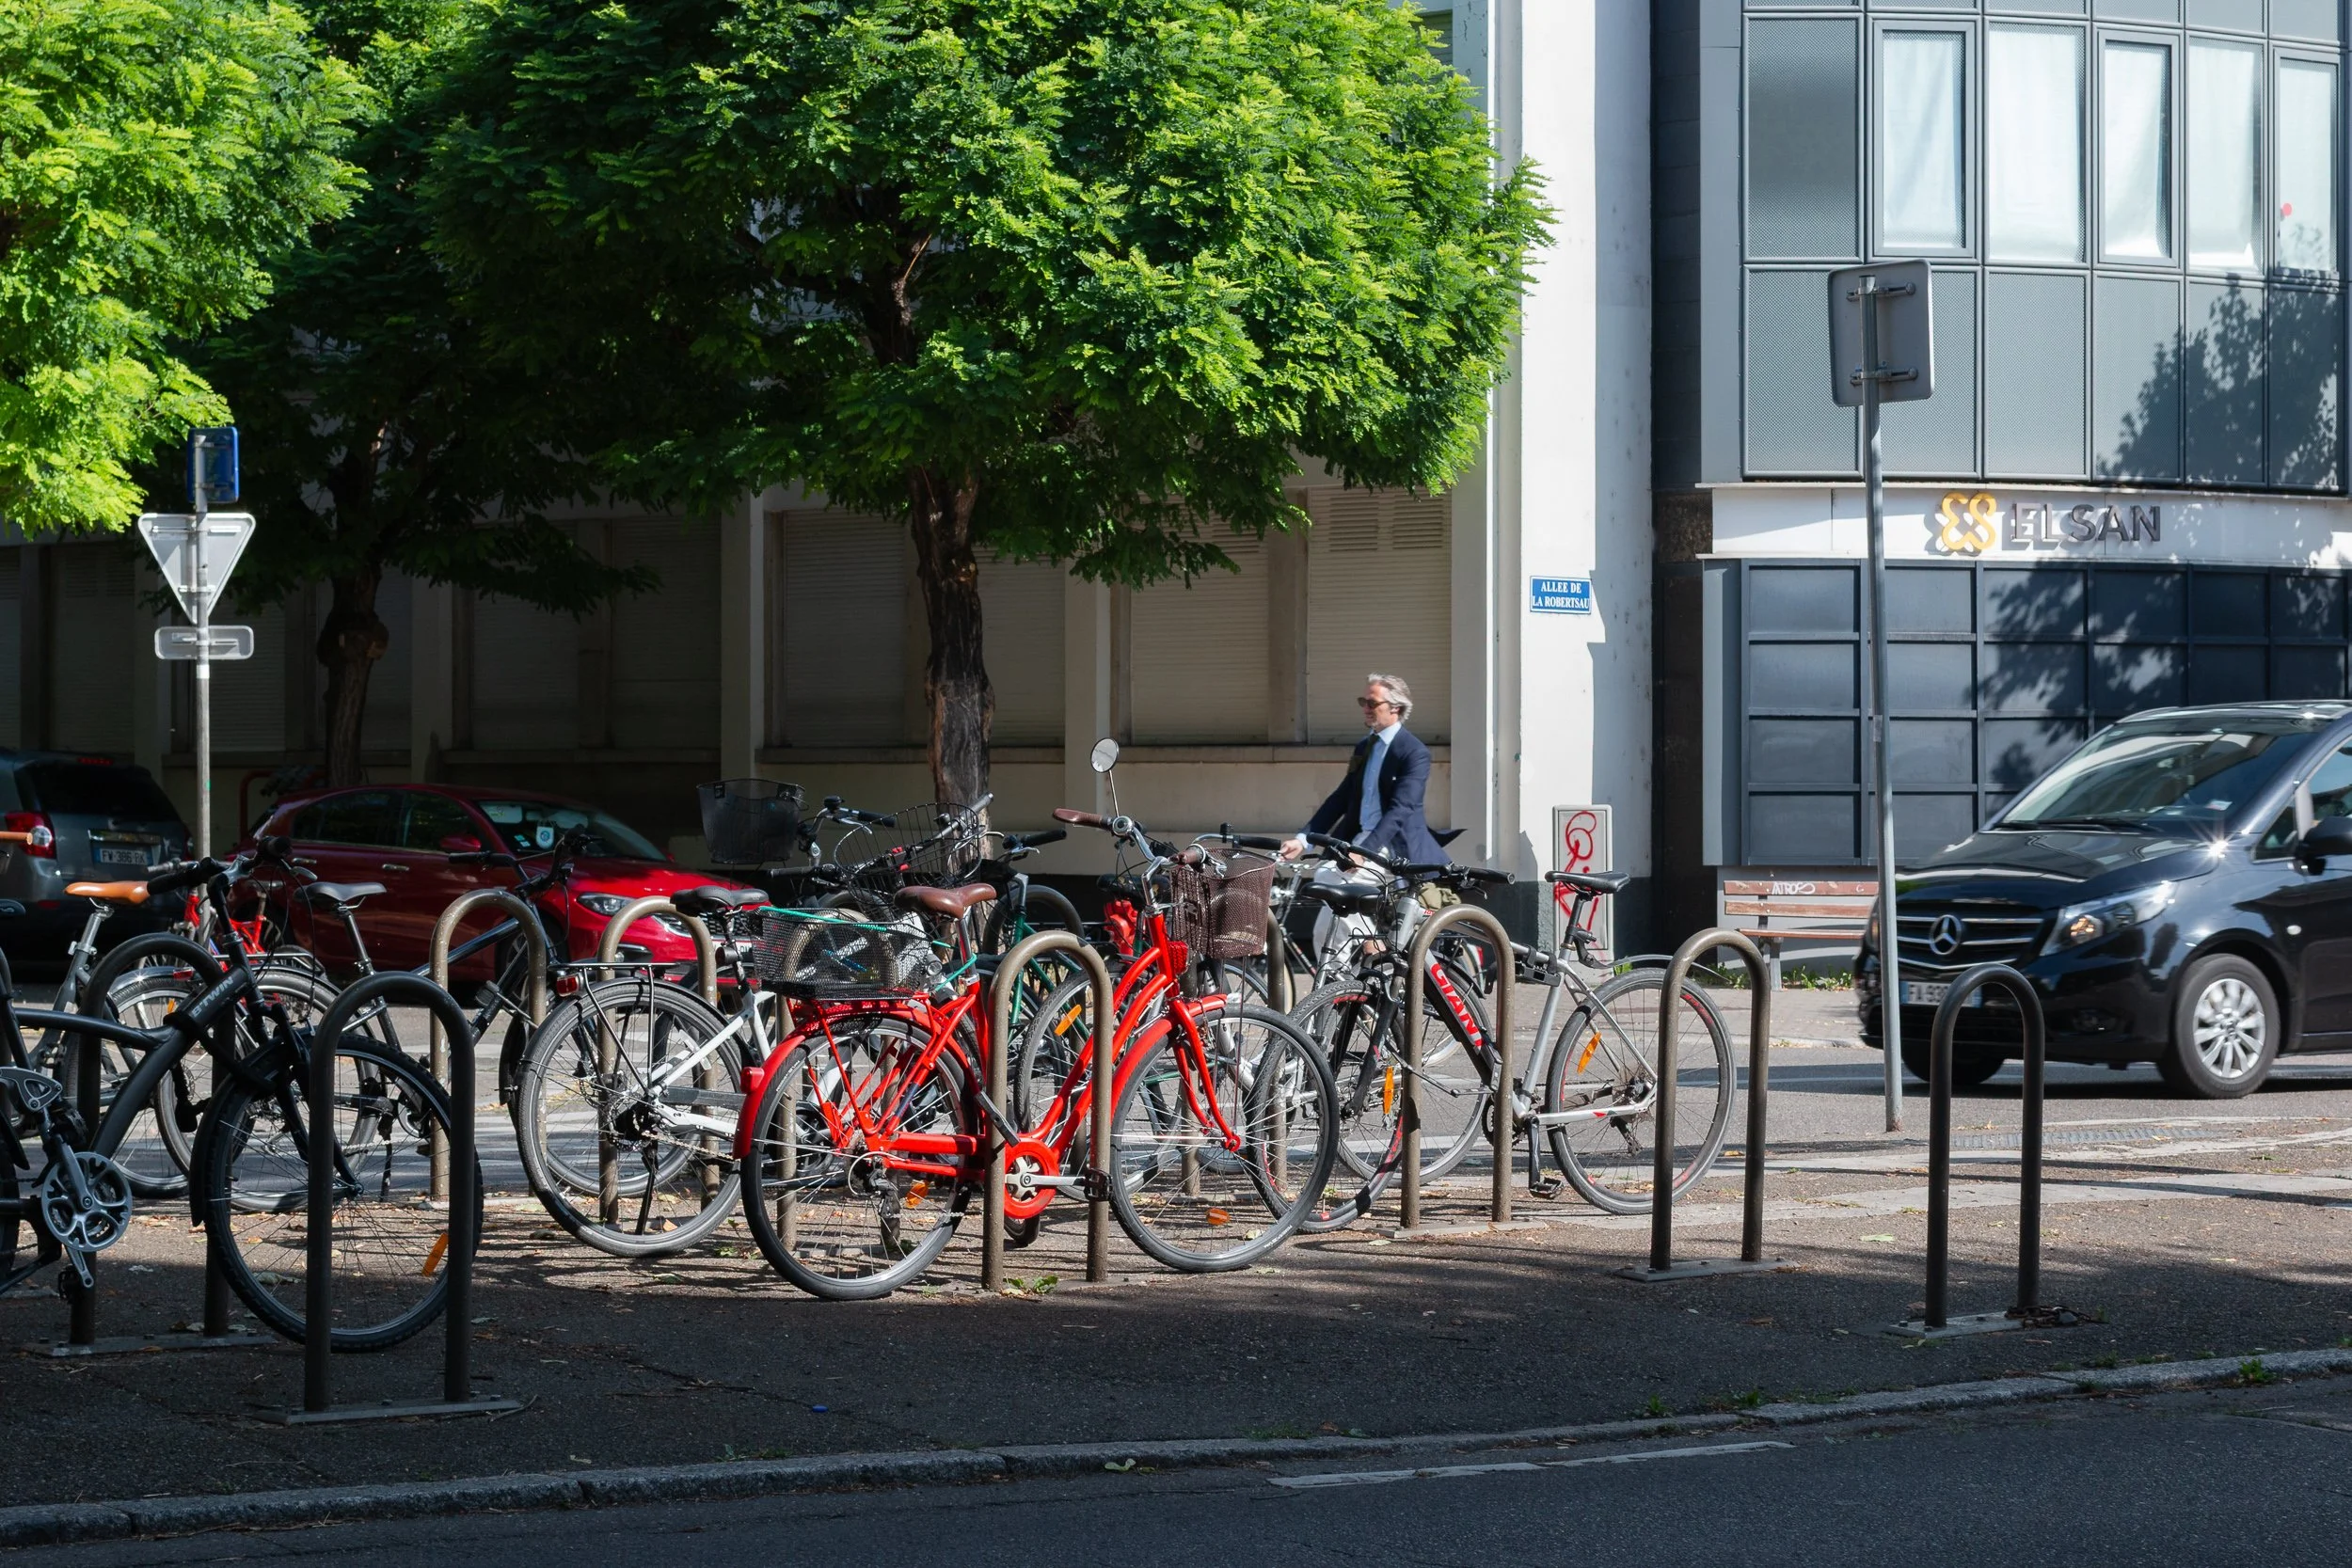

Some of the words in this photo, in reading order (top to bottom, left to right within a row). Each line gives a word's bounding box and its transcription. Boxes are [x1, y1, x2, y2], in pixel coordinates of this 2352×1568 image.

[2013, 502, 2161, 543] ELSAN
[1541, 581, 1568, 593] ALLEE
[1570, 582, 1582, 594] DE
[1533, 595, 1544, 607] LA
[1545, 596, 1590, 609] ROBERTSAU
